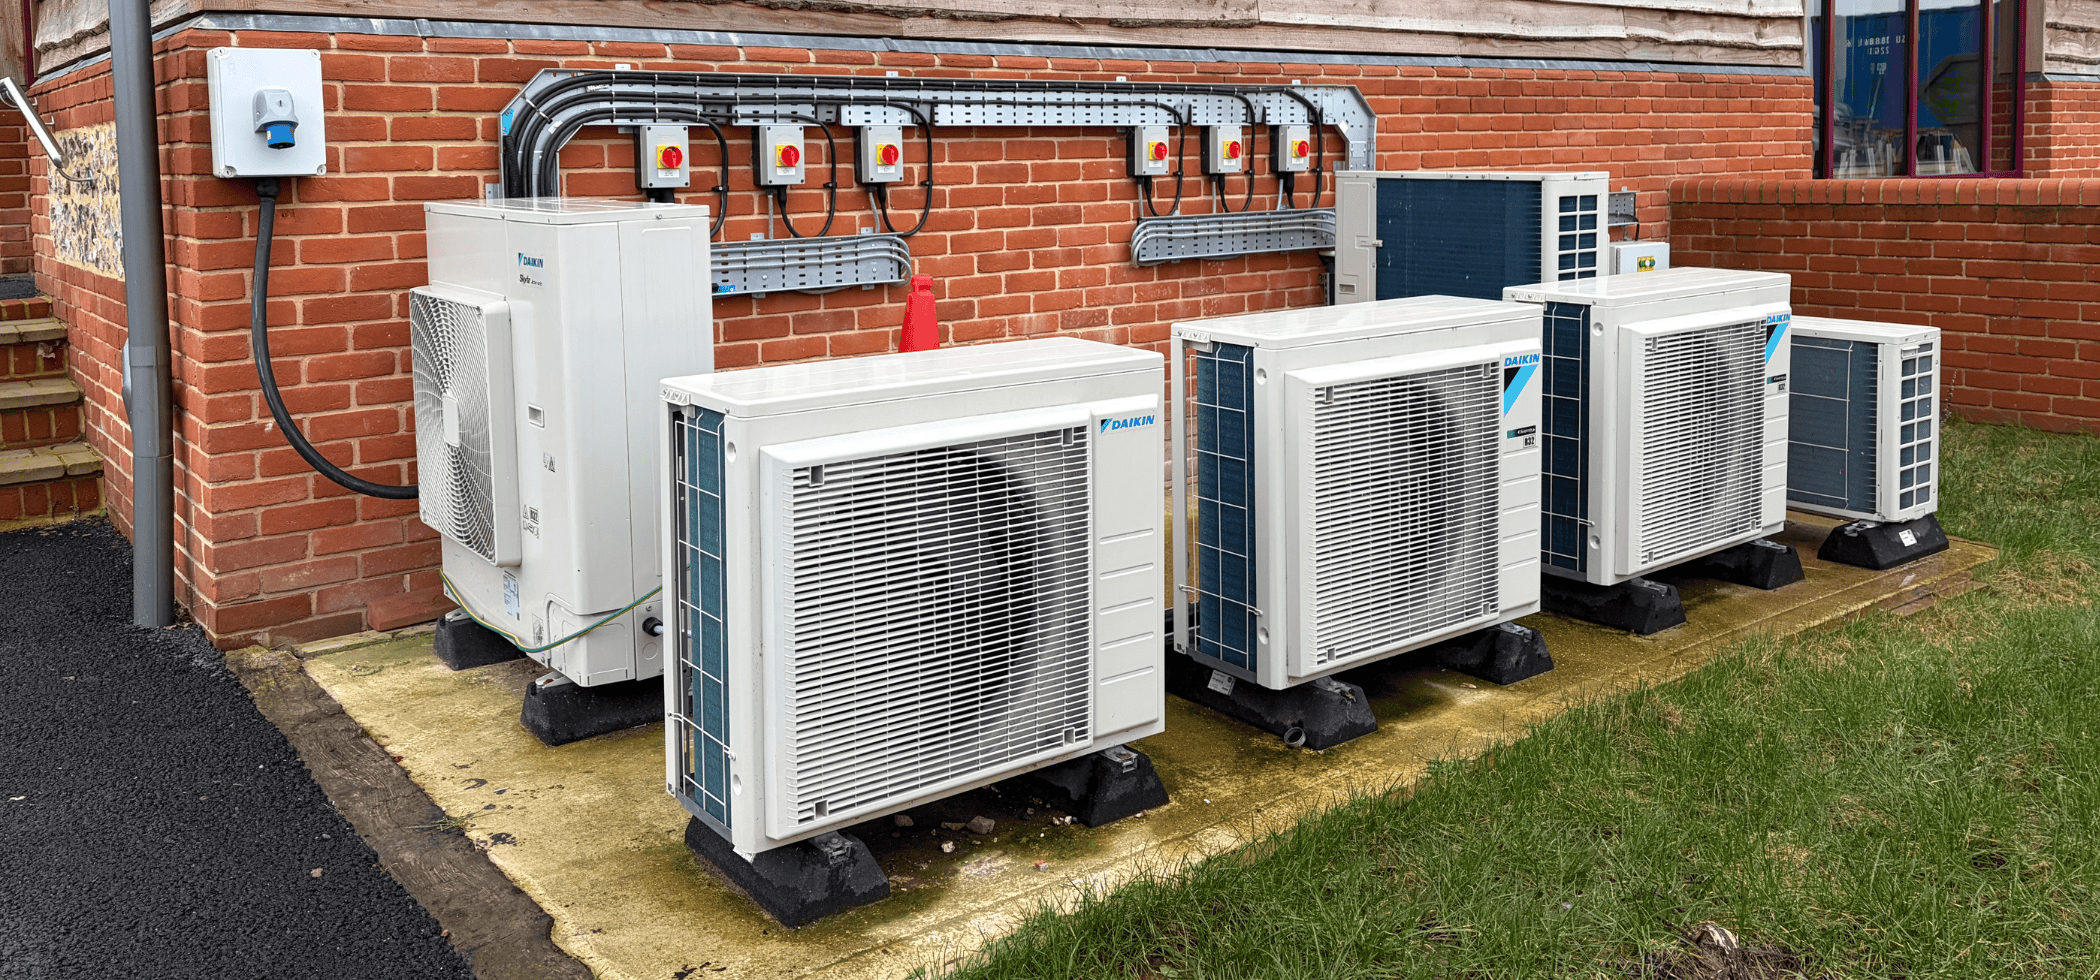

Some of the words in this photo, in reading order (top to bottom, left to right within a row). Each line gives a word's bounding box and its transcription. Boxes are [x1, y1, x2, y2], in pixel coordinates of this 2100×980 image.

[523, 256, 544, 268] DAIKIN
[1767, 313, 1791, 323] DAIKIN
[1504, 353, 1540, 366] DAIKIN
[1111, 415, 1155, 430] DAIKIN
[1524, 436, 1535, 447] R32
